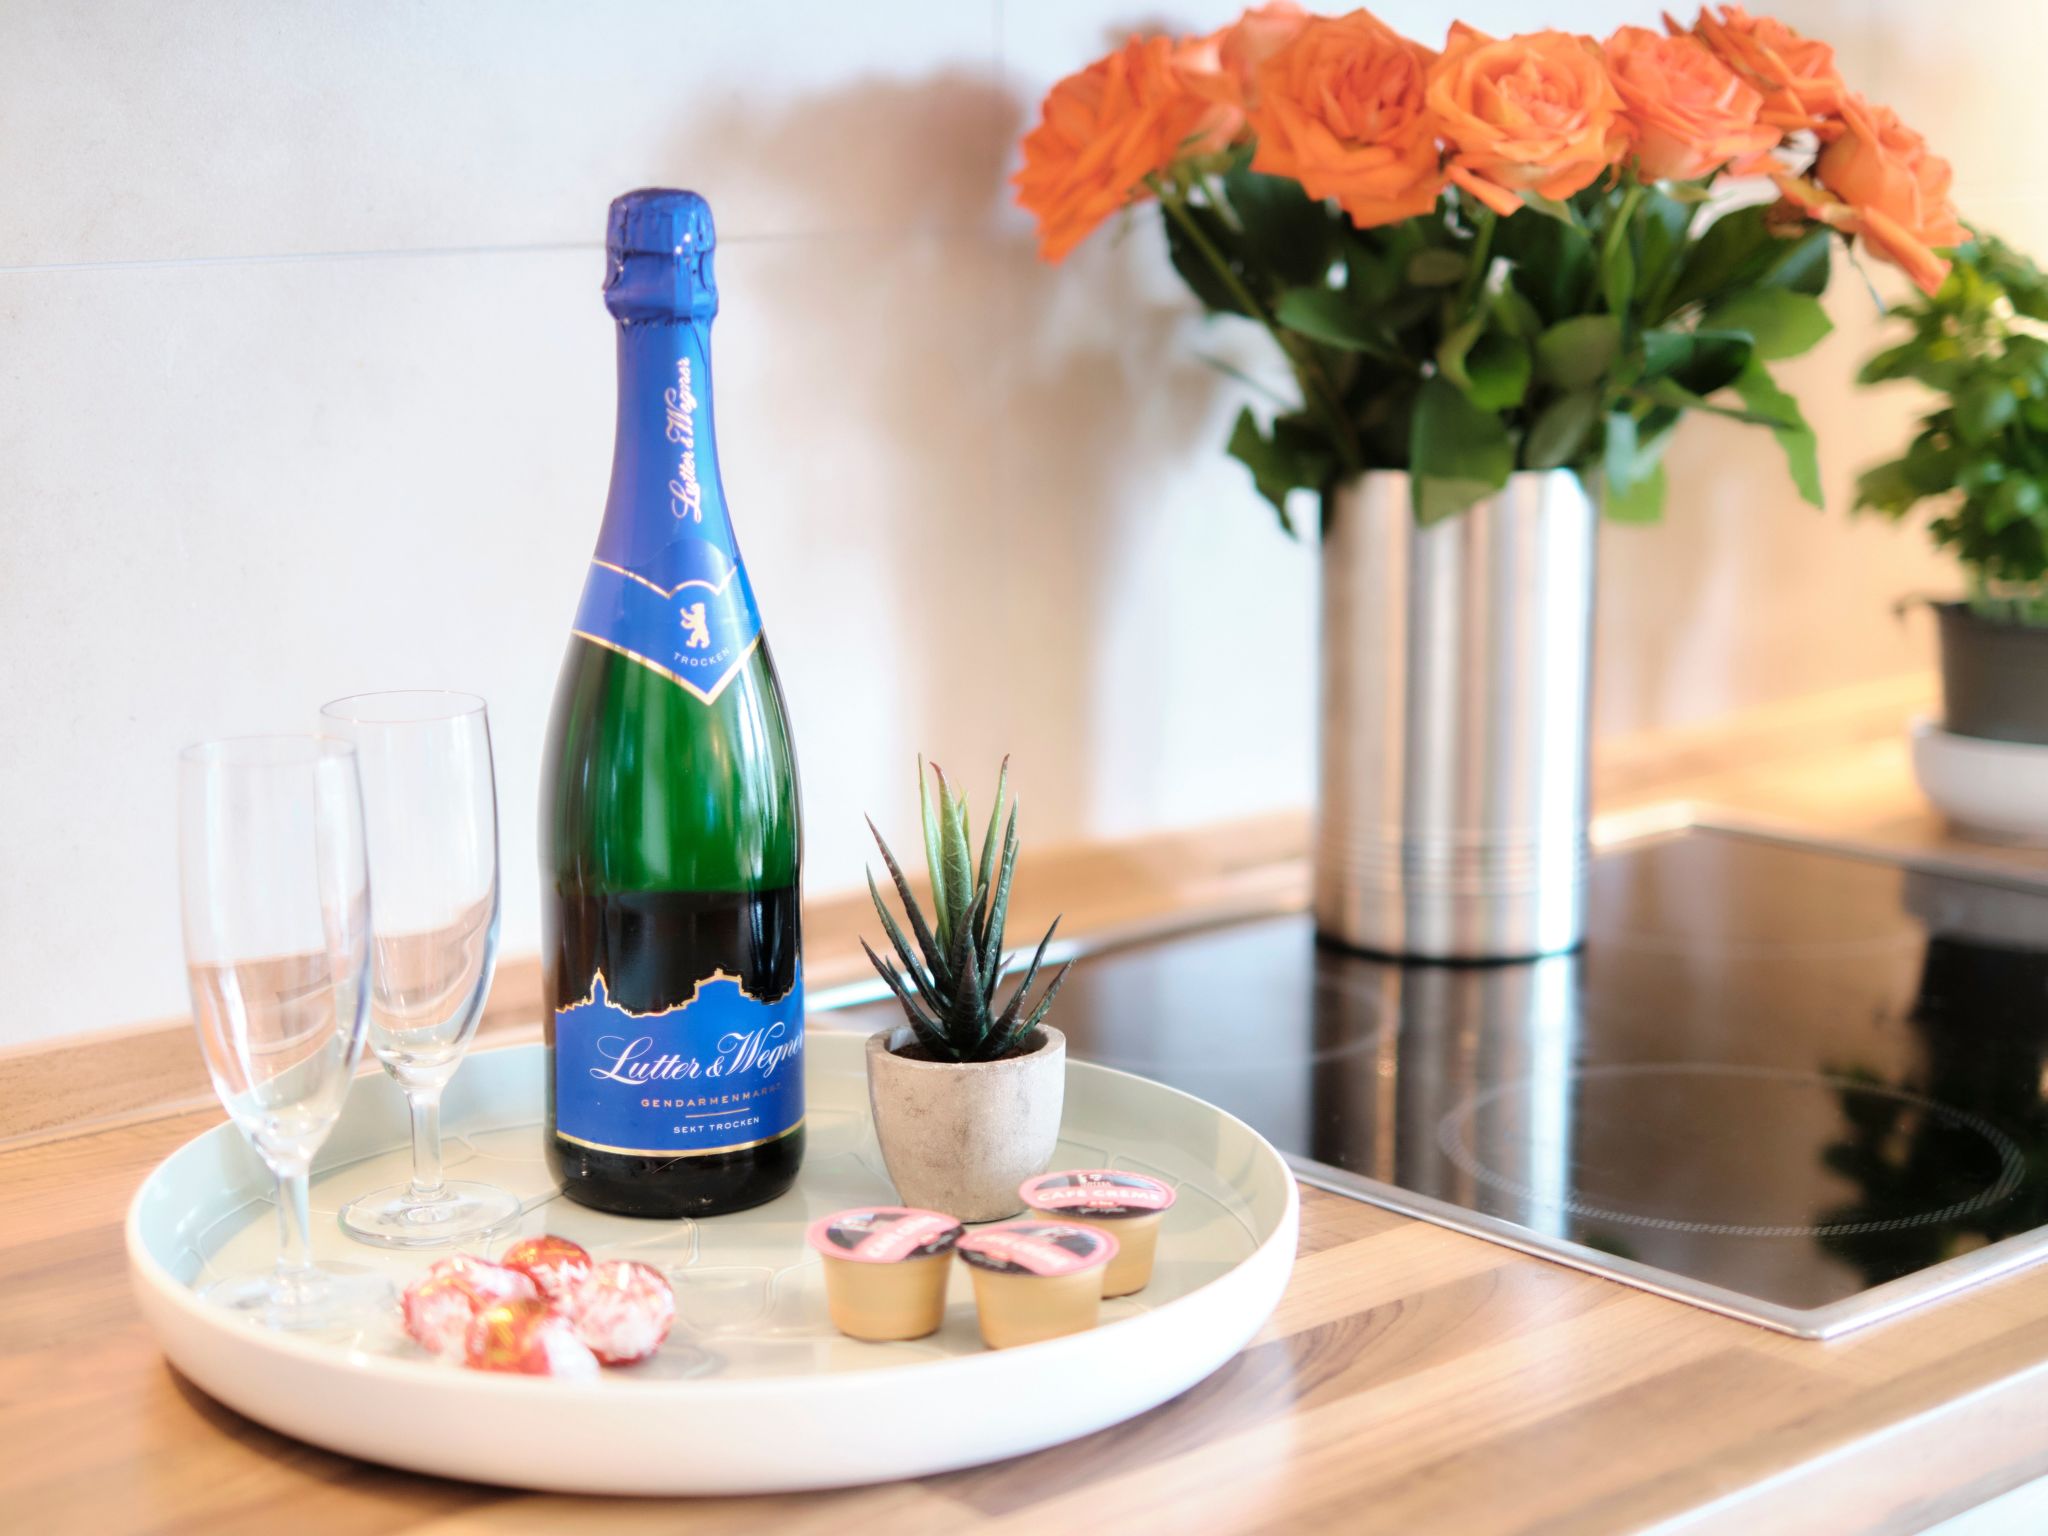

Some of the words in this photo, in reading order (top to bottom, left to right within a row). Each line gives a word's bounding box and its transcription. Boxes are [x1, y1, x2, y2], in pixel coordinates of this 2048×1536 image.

[664, 356, 697, 443] Wegner
[669, 450, 702, 523] Lutter
[674, 646, 730, 667] TROCKEN
[589, 1035, 702, 1085] Lutter
[706, 1055, 724, 1078] &
[673, 1124, 704, 1134] SEKT
[709, 1116, 760, 1131] TROCKEN
